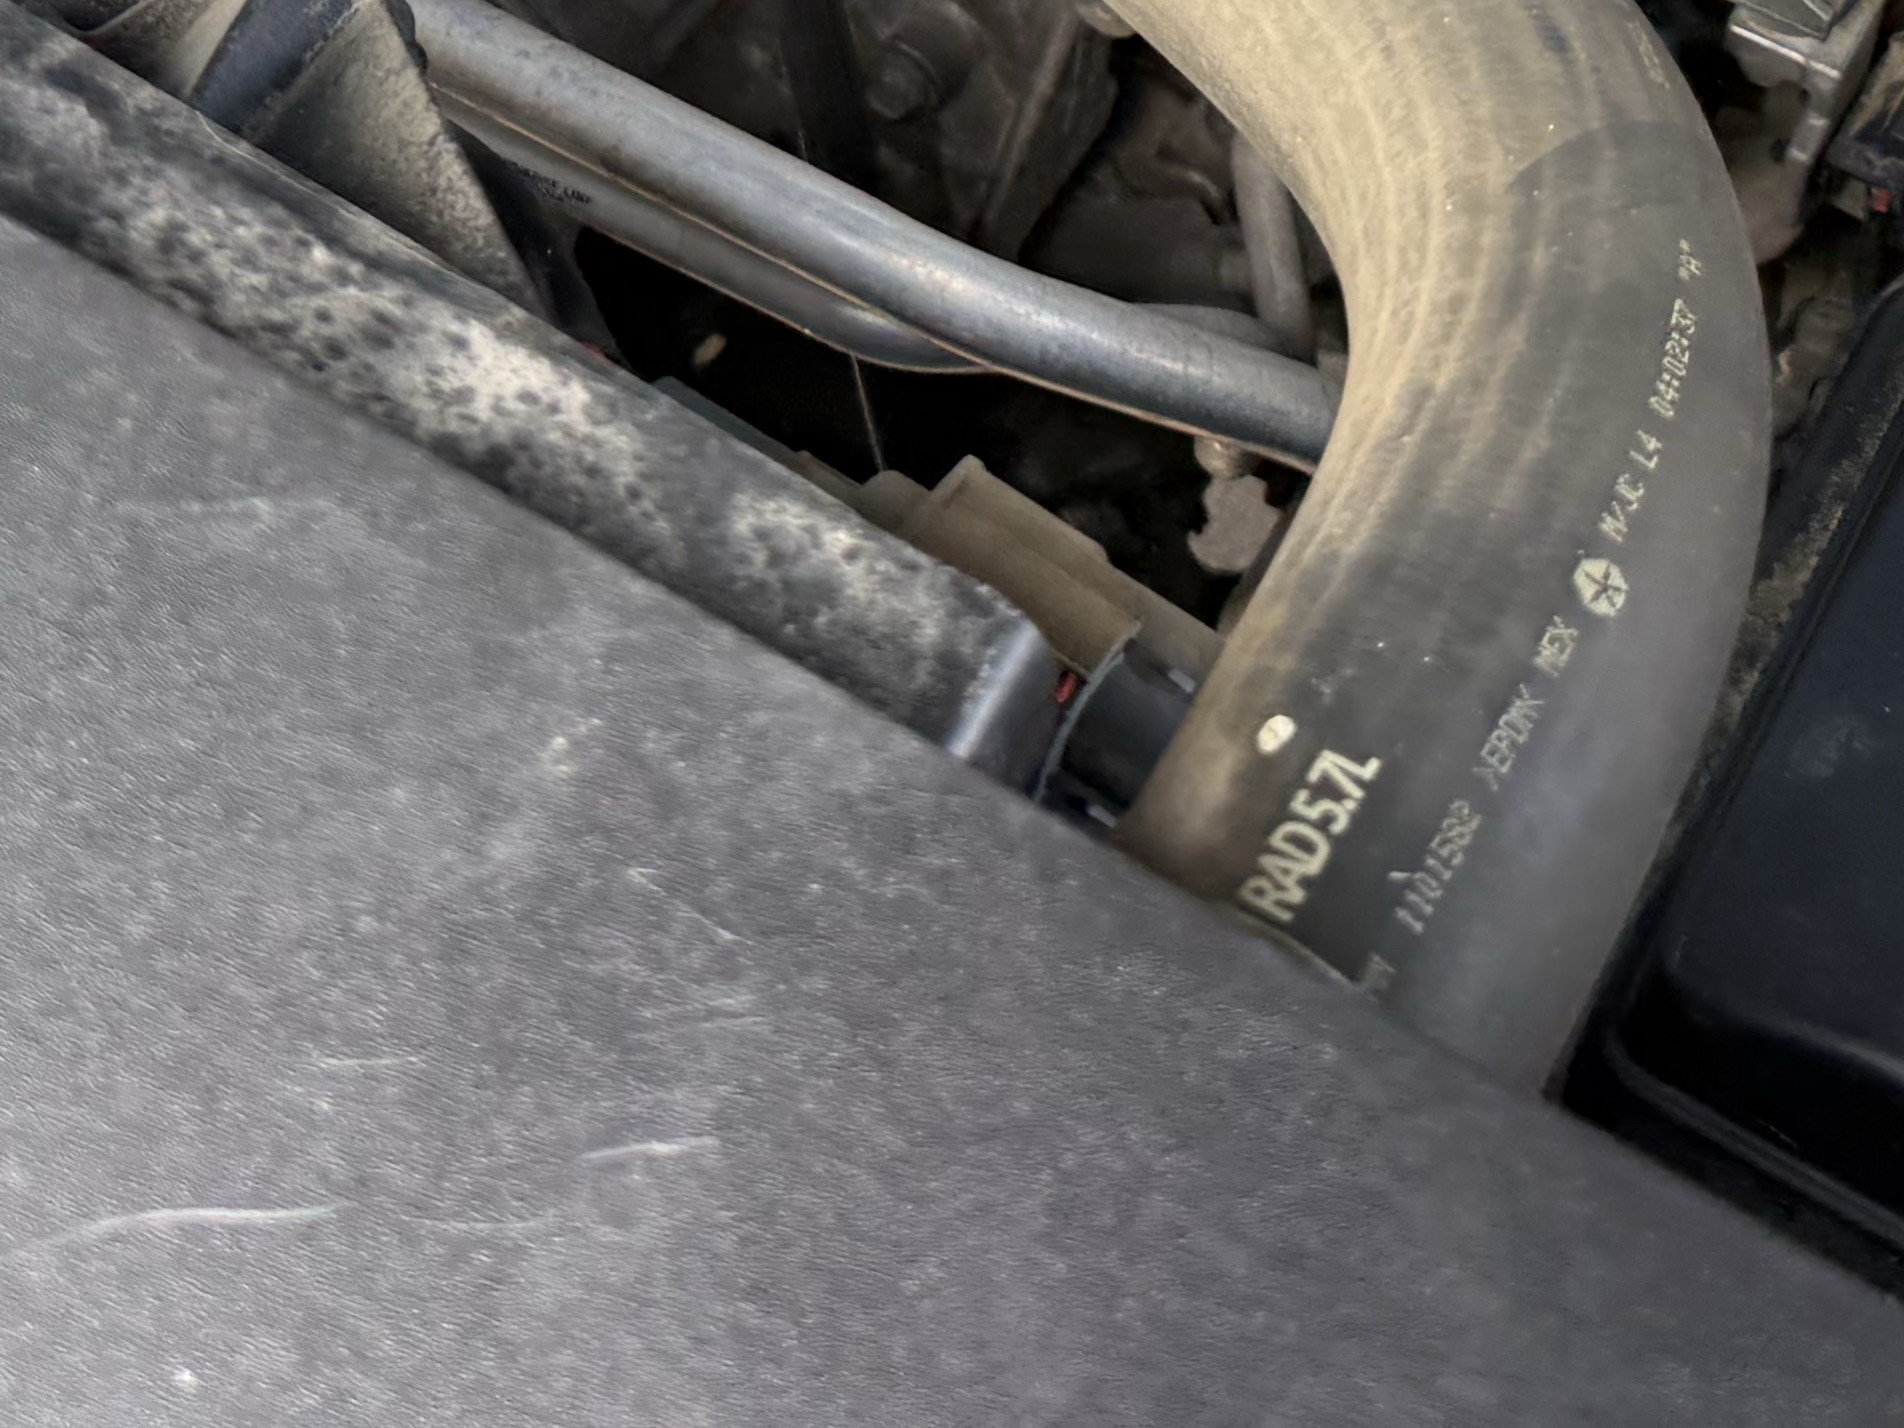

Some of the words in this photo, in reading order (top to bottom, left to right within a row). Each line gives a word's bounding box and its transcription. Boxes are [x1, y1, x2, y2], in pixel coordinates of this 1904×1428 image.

[1628, 427, 1664, 471] L4
[1647, 297, 1699, 421] 04:02:37
[1239, 820, 1332, 922] RAD
[1290, 748, 1382, 836] 5.7L
